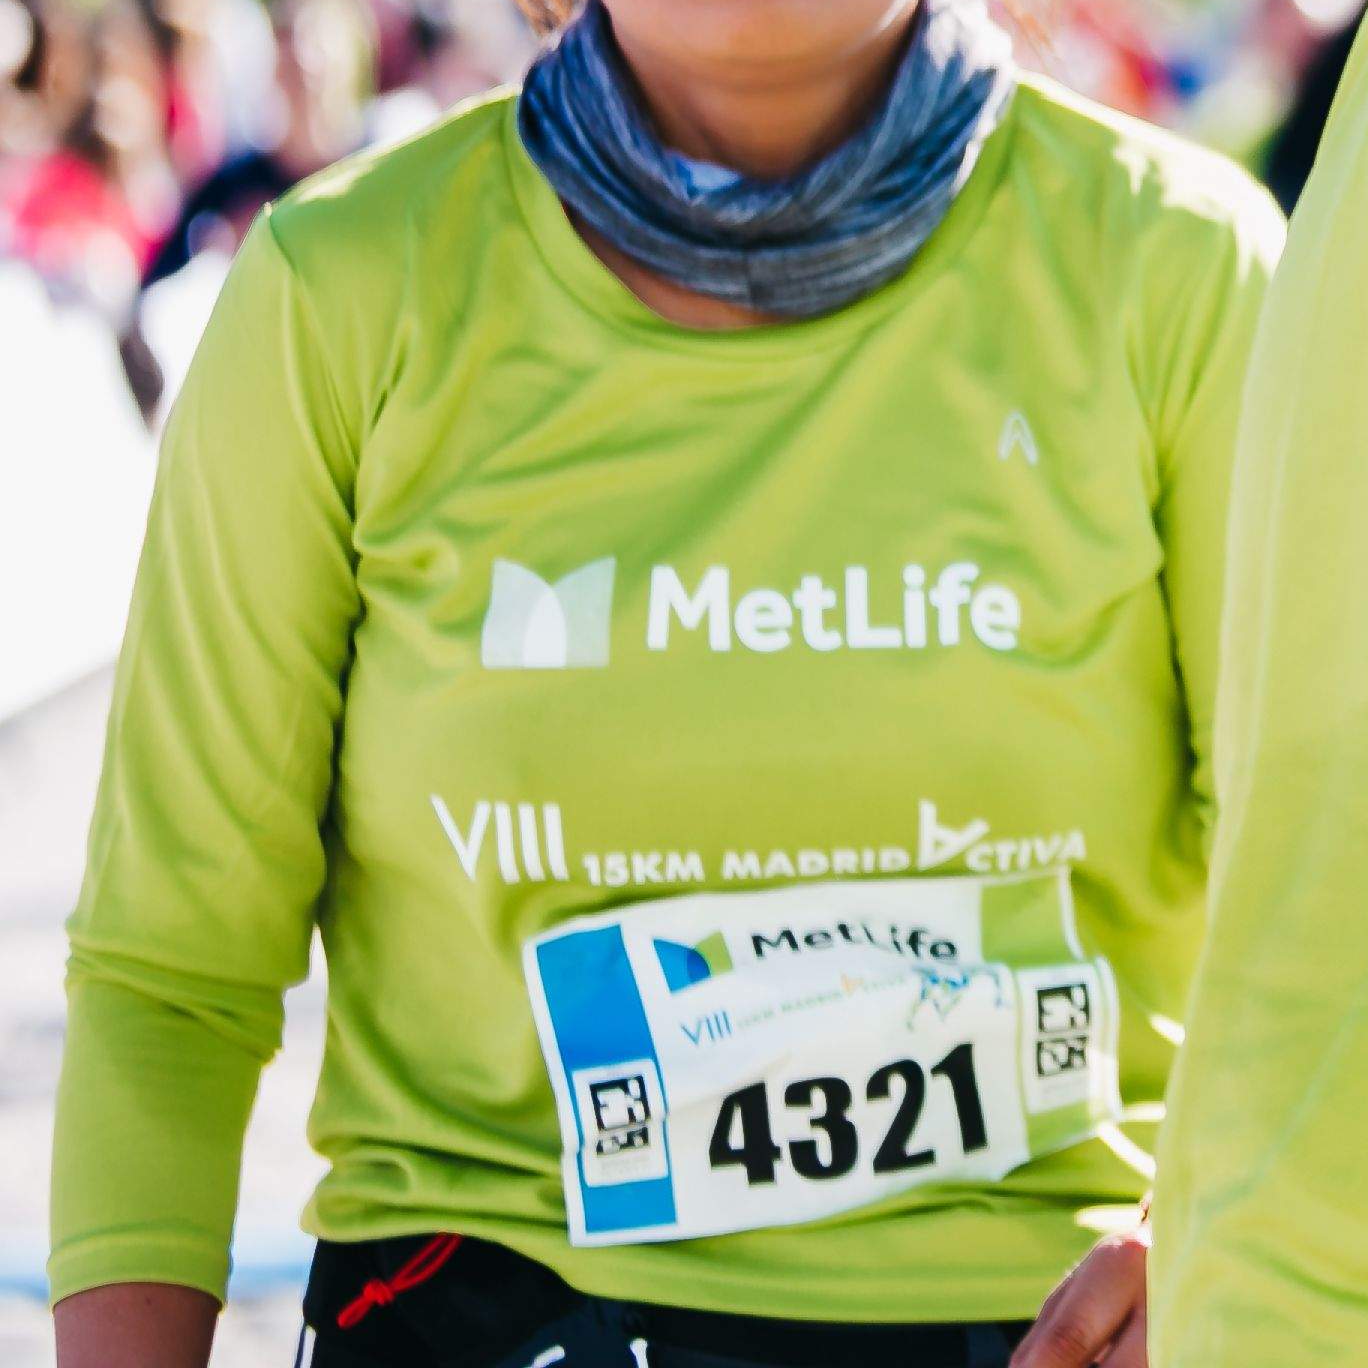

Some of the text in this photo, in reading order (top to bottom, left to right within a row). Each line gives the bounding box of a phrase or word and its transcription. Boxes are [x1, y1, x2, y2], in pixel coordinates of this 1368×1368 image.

[646, 561, 1021, 653] MetLife
[430, 794, 570, 884] VIII
[582, 850, 706, 887] 15KM
[722, 847, 911, 880] MADRID
[751, 921, 957, 959] MetLife
[680, 1011, 732, 1046] VIII
[709, 1043, 987, 1186] 4321
